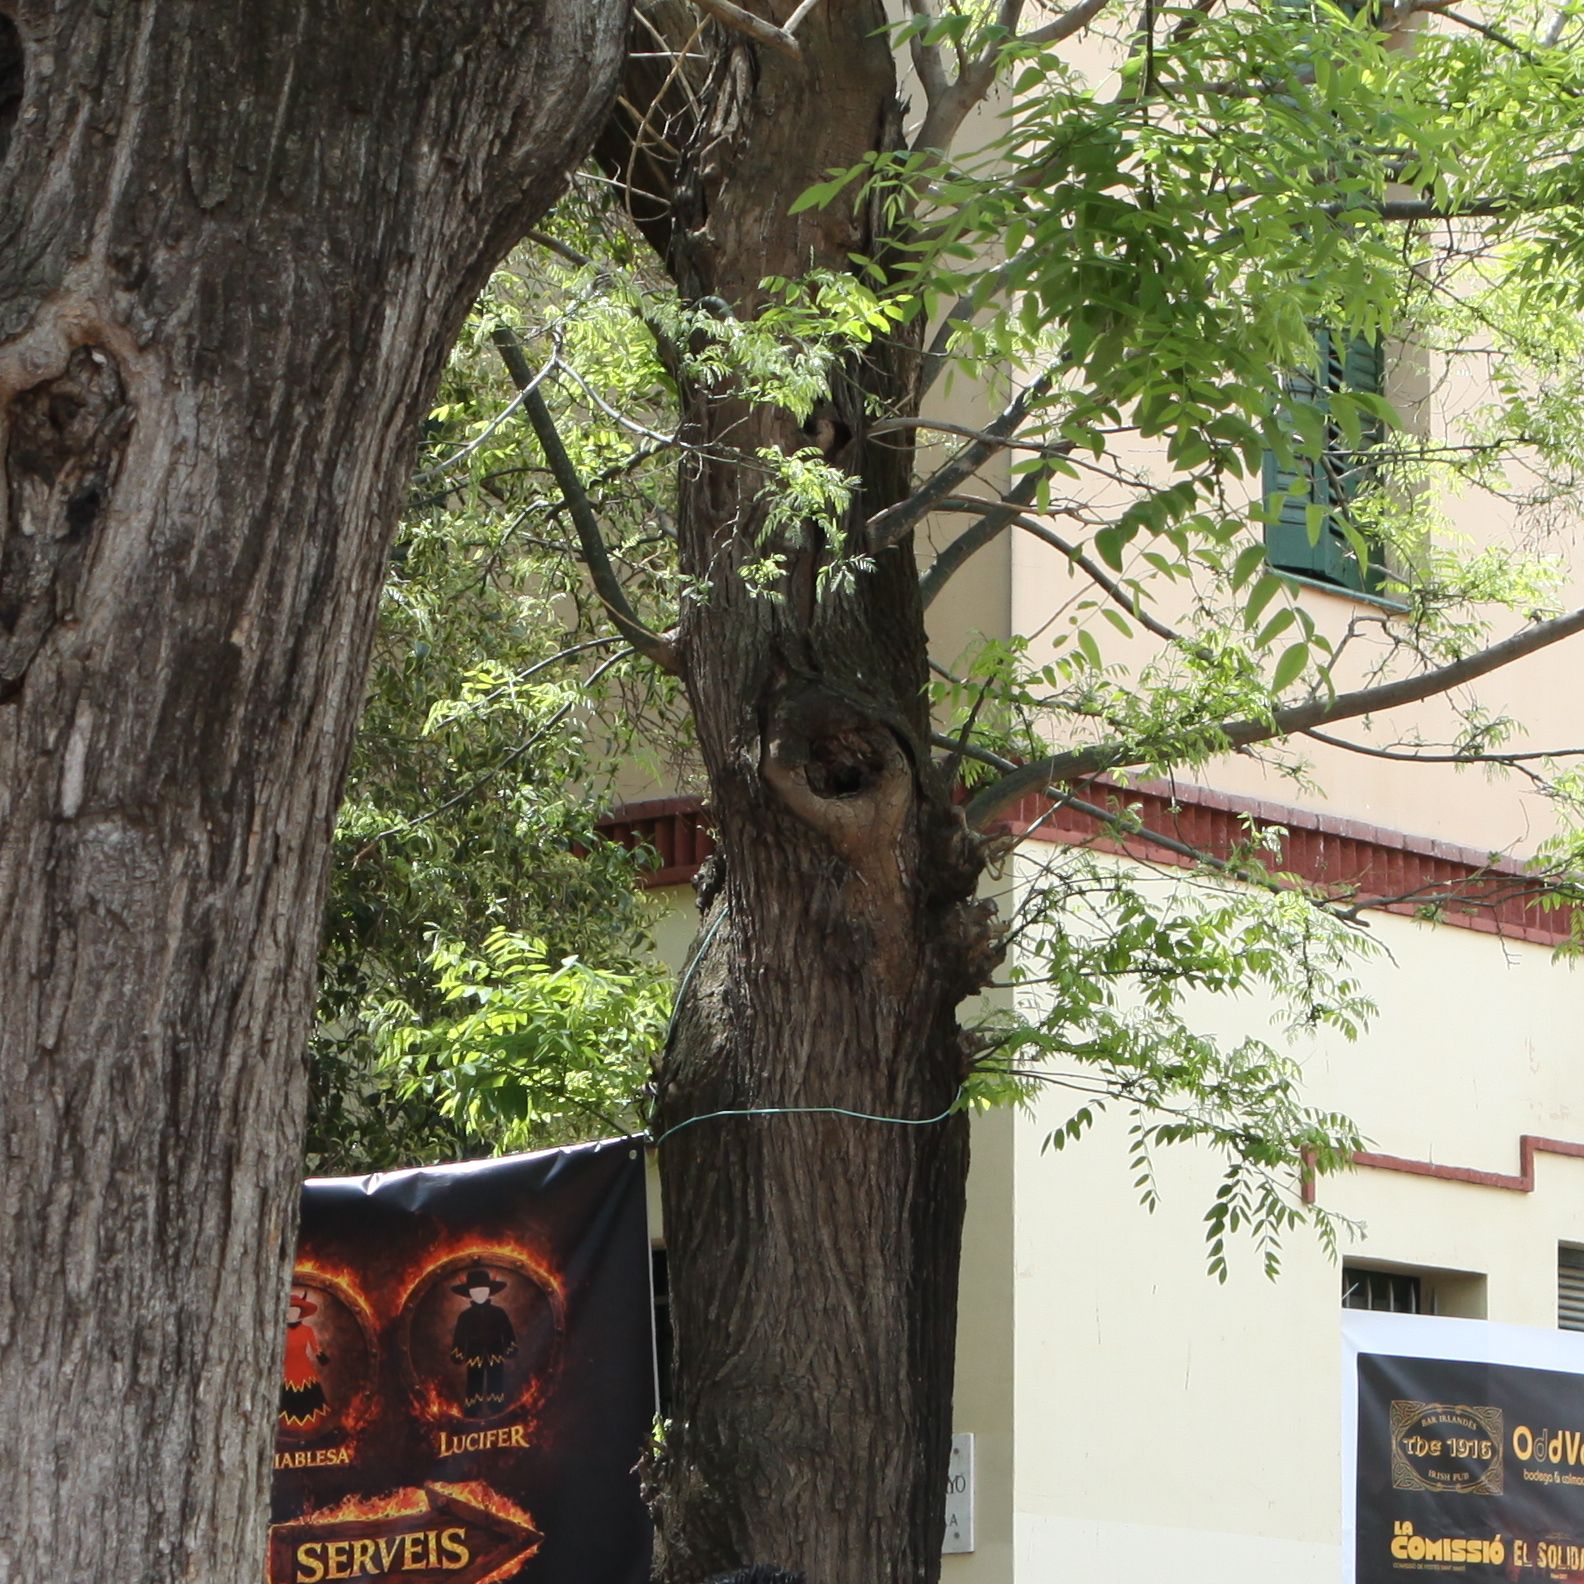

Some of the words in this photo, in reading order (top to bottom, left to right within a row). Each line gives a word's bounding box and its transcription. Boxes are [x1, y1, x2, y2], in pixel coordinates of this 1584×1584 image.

[438, 1425, 530, 1458] LUCIFER
[273, 1447, 350, 1470] IABLESA
[1393, 1520, 1413, 1536] LA
[296, 1527, 470, 1584] SERVEIS
[1390, 1534, 1505, 1566] COMISSIÓ
[1514, 1539, 1532, 1568] EL
